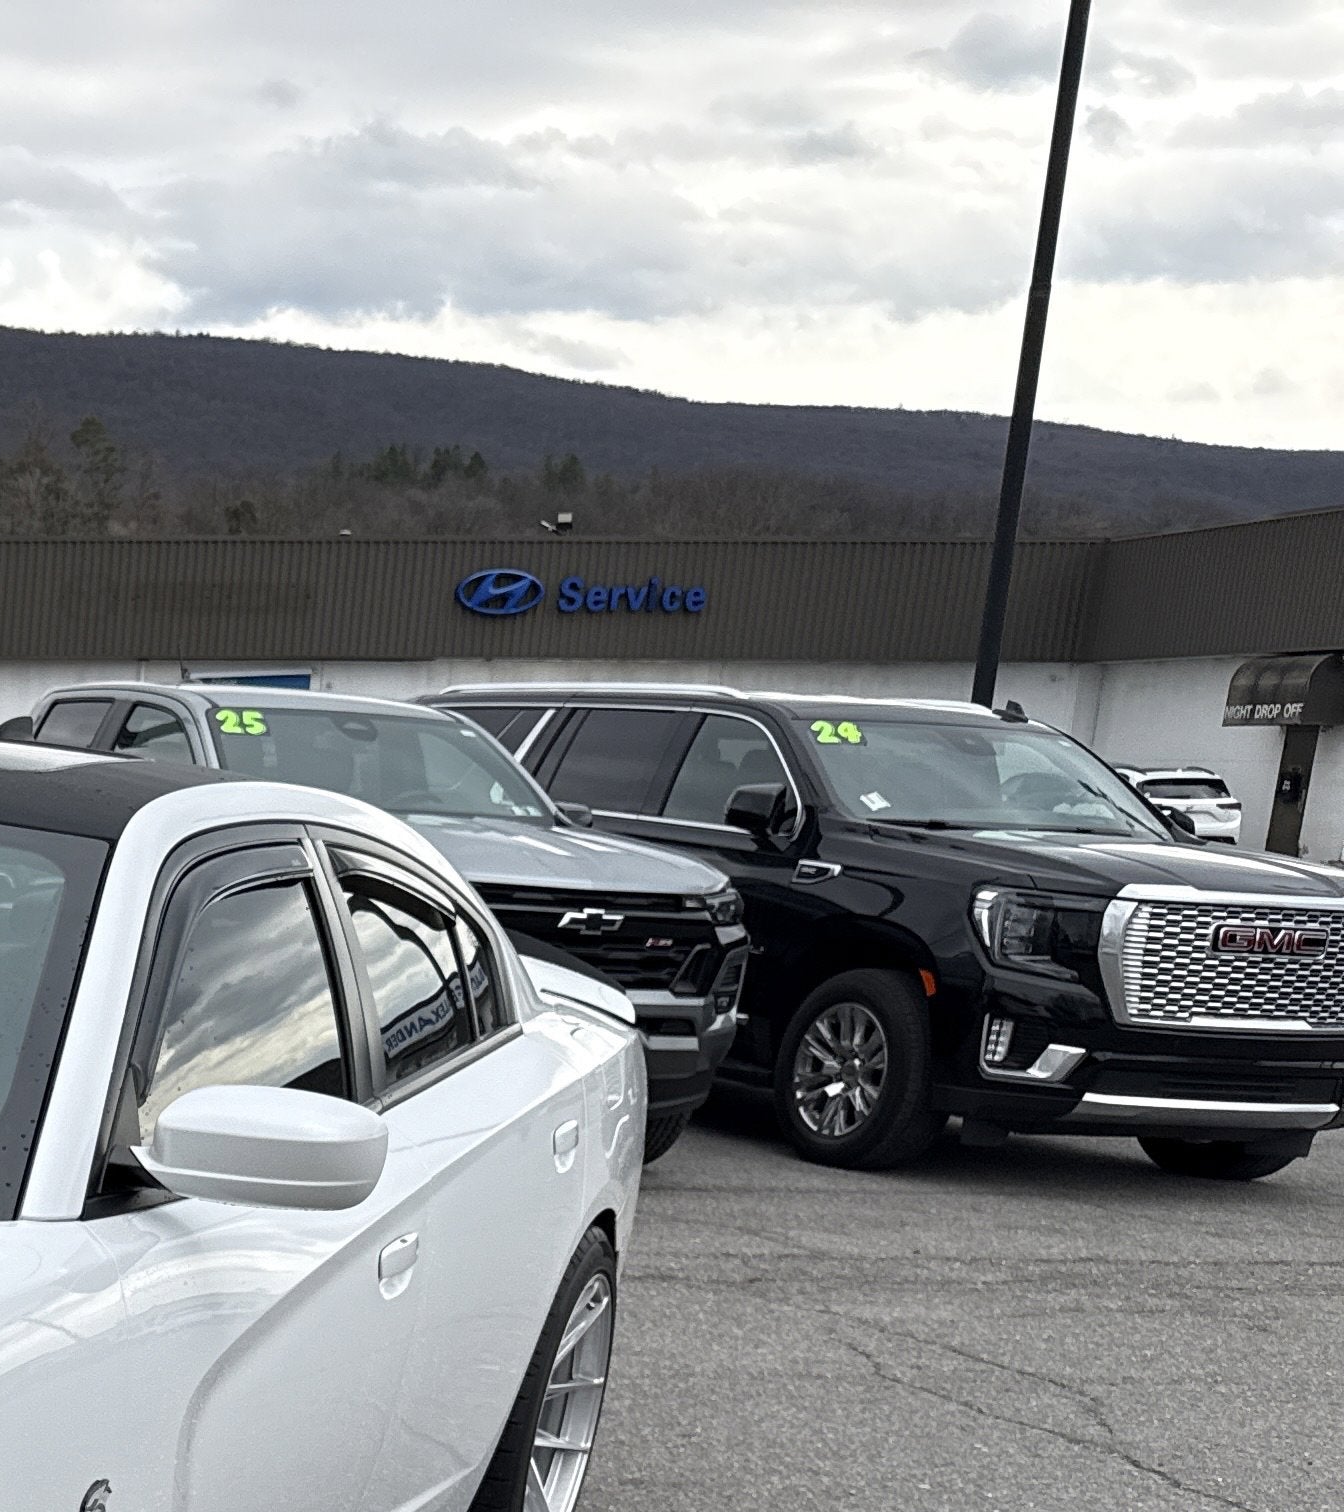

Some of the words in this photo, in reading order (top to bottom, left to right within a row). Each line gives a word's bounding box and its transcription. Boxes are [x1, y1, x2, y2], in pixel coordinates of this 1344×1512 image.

[558, 575, 707, 613] Service
[215, 709, 267, 735] 25
[1224, 704, 1253, 719] NIGHT
[1254, 703, 1281, 719] DROP
[1283, 702, 1305, 719] OFF
[810, 720, 862, 744] 24
[1217, 926, 1327, 954] GMC
